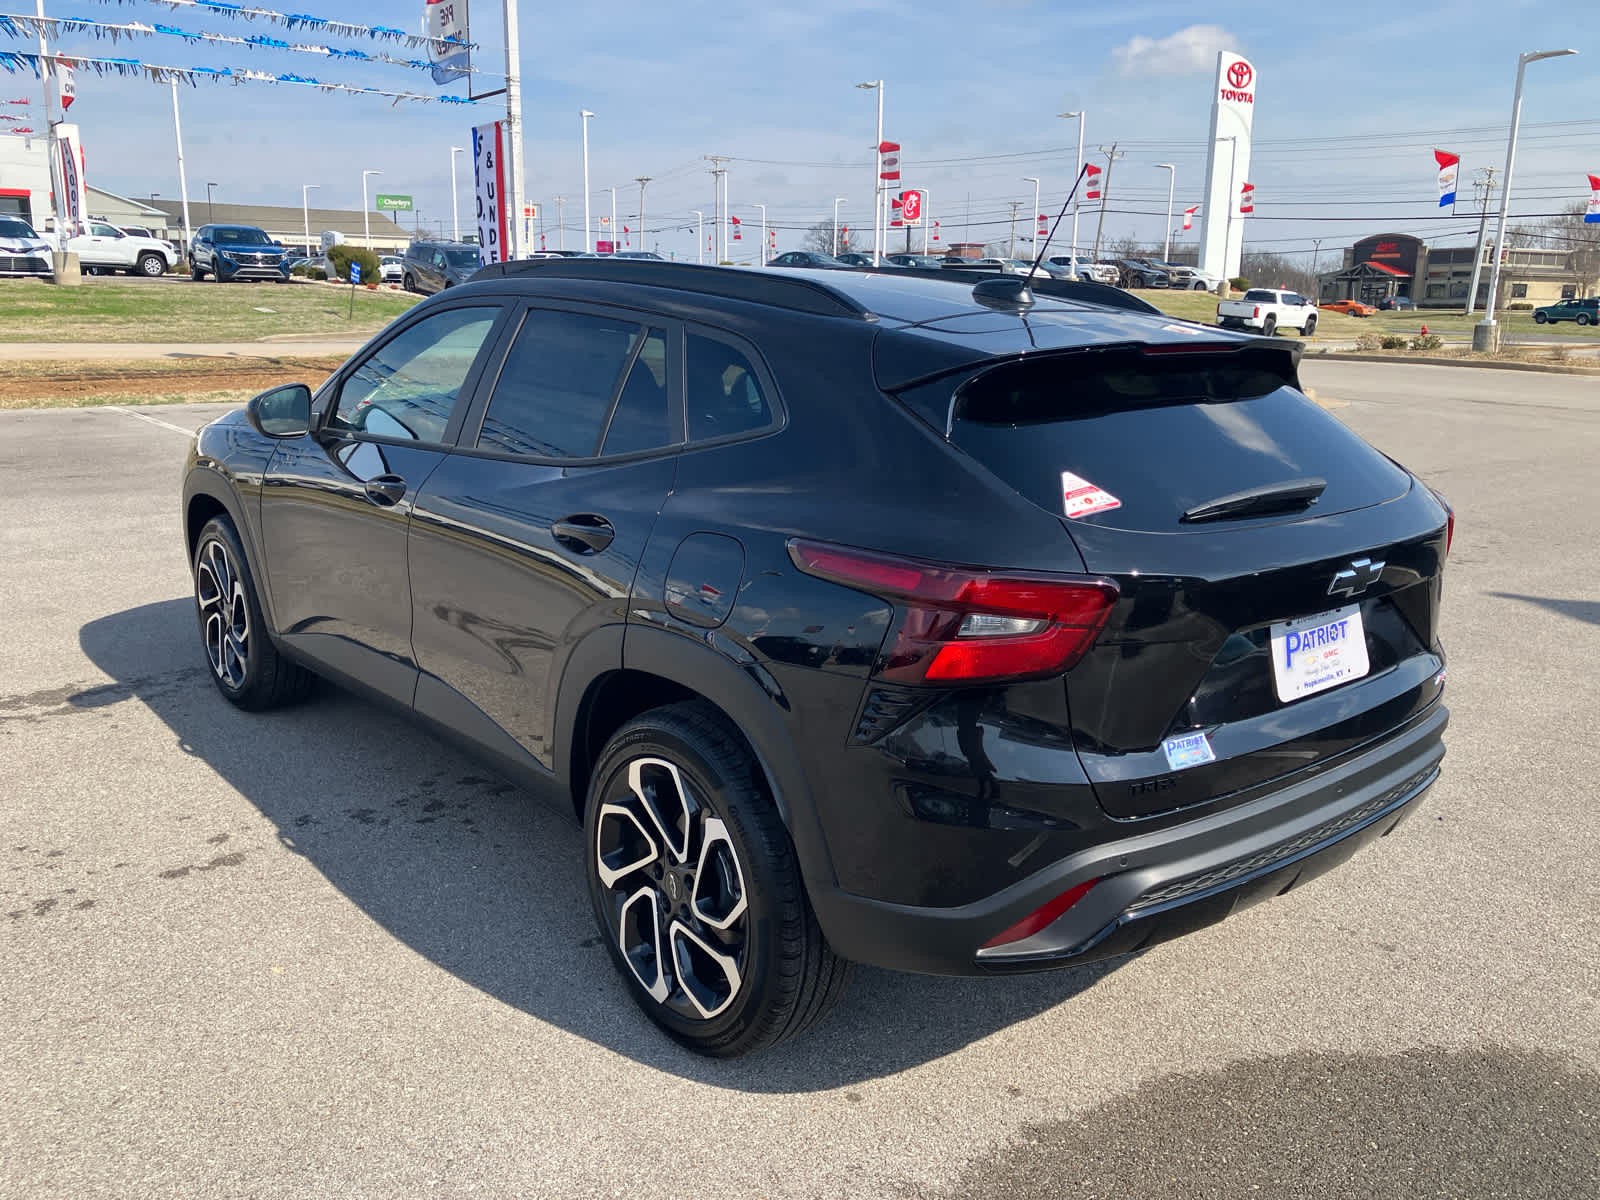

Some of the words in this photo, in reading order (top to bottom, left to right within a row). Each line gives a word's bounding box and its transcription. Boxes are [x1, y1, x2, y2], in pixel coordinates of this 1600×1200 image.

[1220, 88, 1253, 104] TOYOTA
[486, 151, 493, 168] &
[486, 181, 497, 265] UNDE
[1286, 620, 1348, 668] PATRIOT
[1167, 735, 1204, 757] PATRIOT
